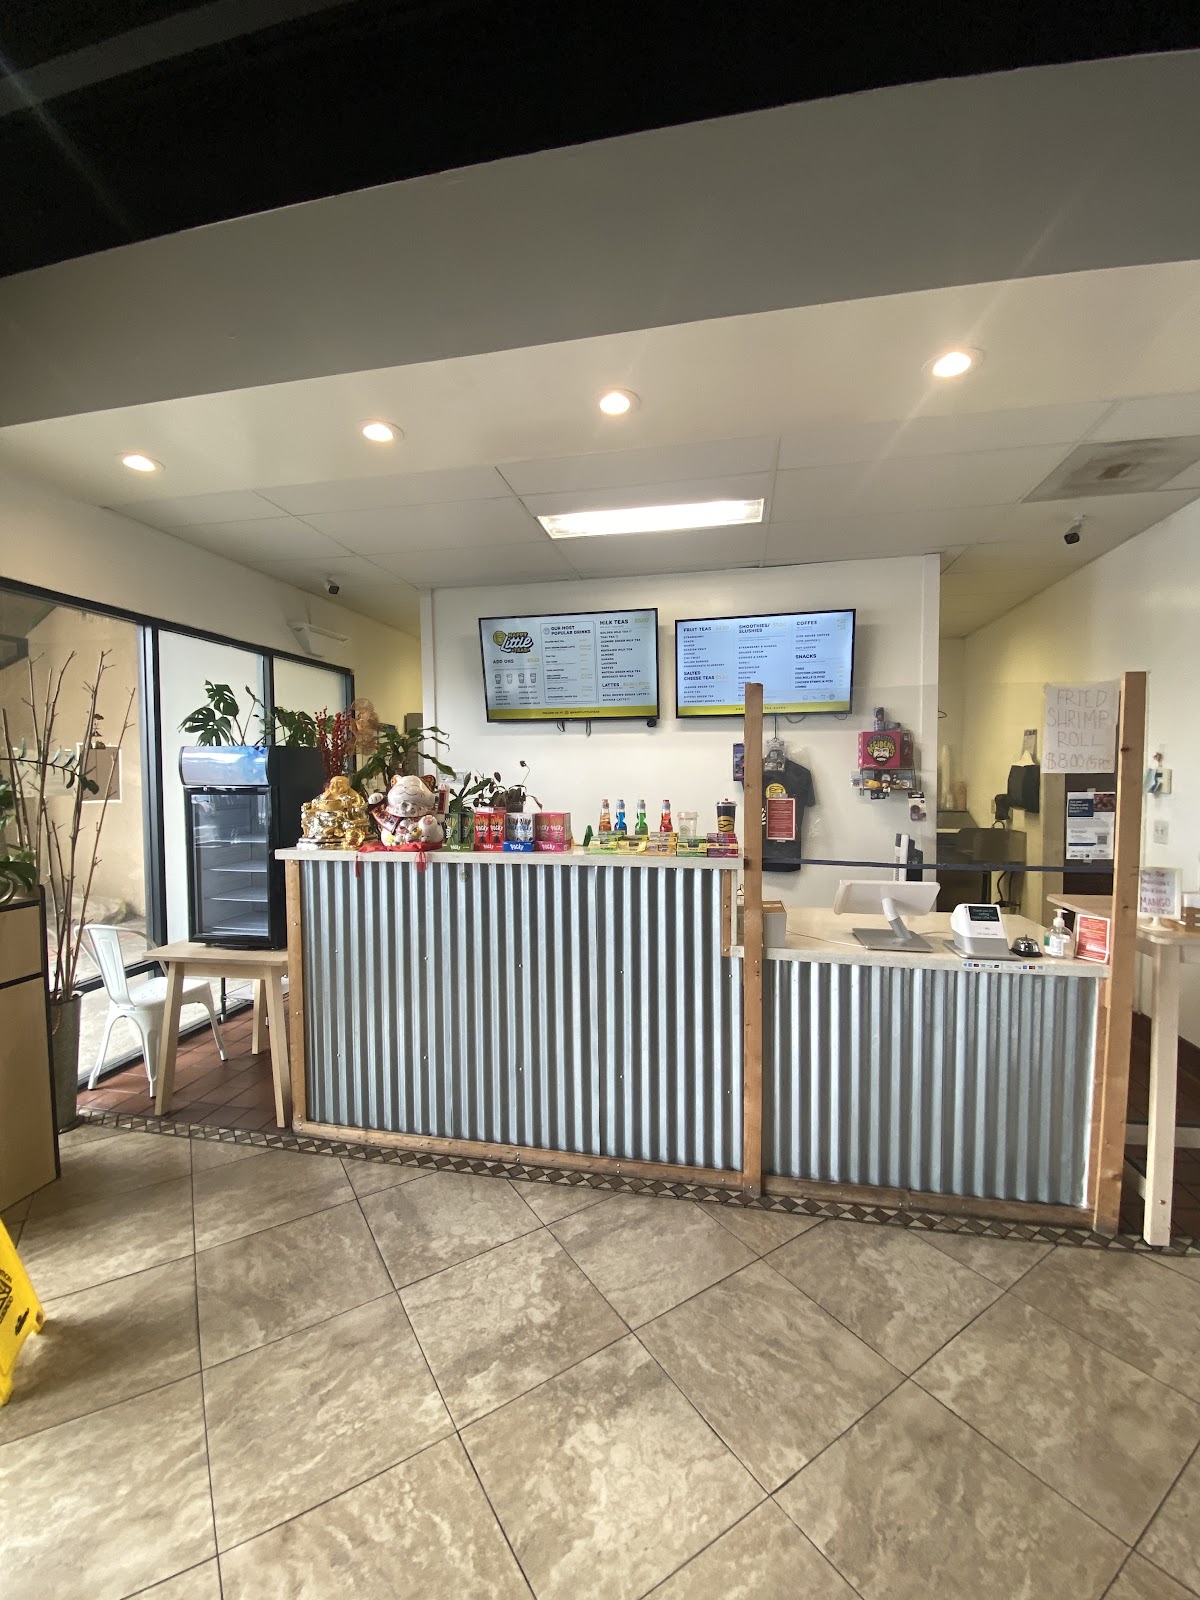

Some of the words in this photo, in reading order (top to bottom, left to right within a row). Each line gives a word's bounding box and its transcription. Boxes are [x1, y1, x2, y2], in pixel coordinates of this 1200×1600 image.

[500, 635, 534, 653] Little
[1057, 689, 1108, 708] FRIED
[1047, 706, 1110, 729] SHRIMP
[1058, 731, 1104, 748] ROLL
[1140, 896, 1170, 907] MANGO
